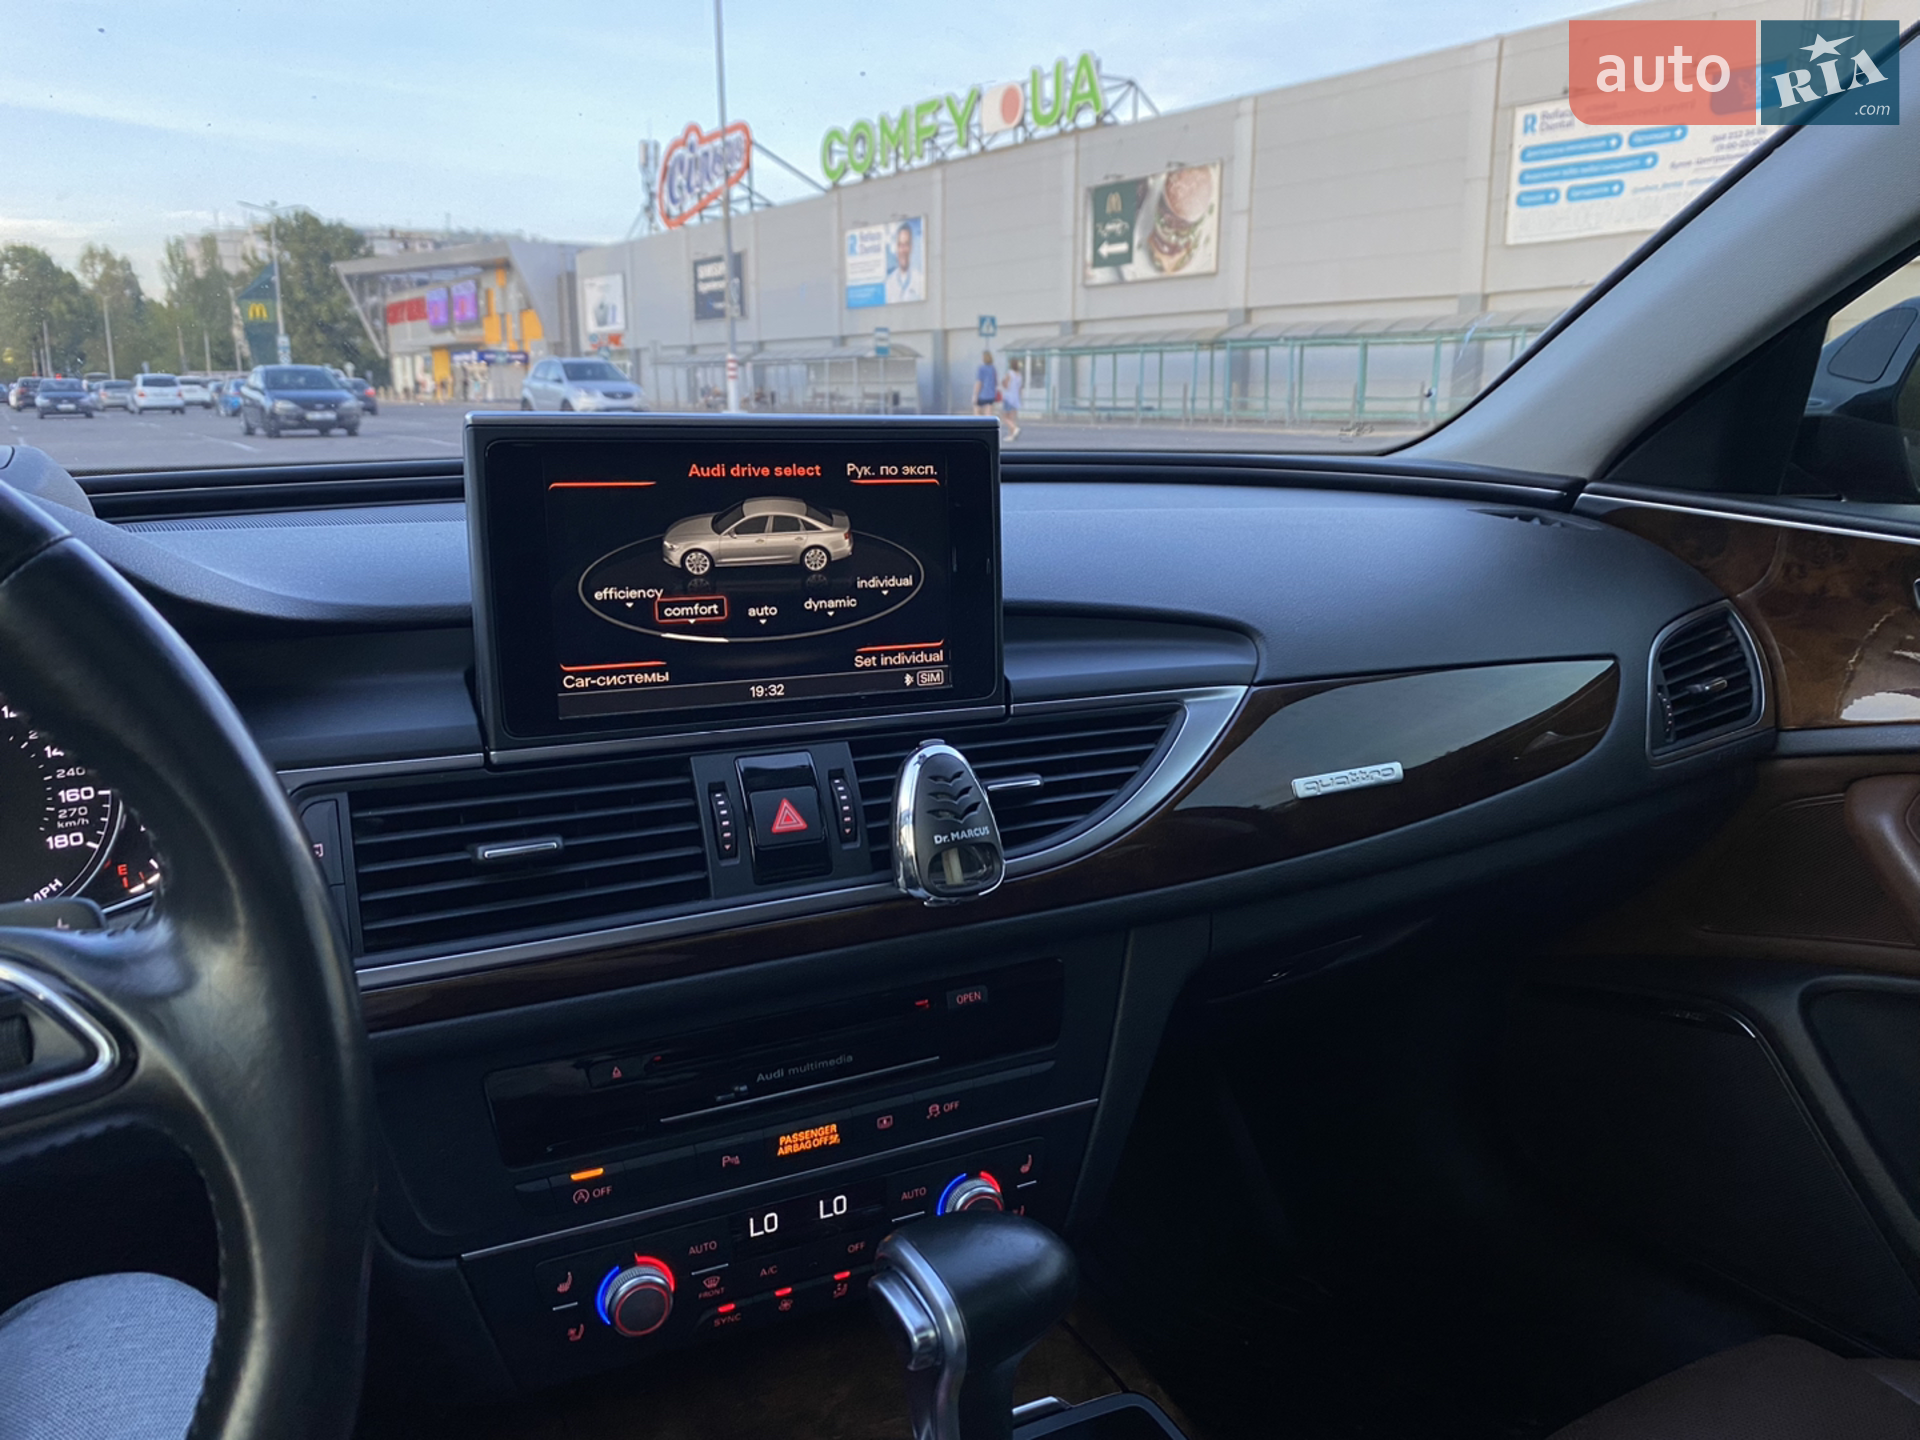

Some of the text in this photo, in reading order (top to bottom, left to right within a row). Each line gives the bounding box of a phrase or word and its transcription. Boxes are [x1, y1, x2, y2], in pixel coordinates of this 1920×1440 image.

[821, 53, 1103, 183] COMFY UA
[688, 463, 822, 477] Audi drive select
[847, 463, 938, 479] Рук. по эксп.
[856, 575, 913, 589] individual
[594, 587, 664, 601] efficiency
[663, 603, 719, 617] comfort
[747, 605, 778, 617] auto
[803, 596, 857, 612] dynamic
[854, 650, 944, 668] Set individual
[562, 671, 670, 689] Car-системы
[920, 672, 941, 684] SIM
[749, 684, 785, 698] 19:32
[56, 766, 86, 779] 240
[1303, 767, 1395, 796] quattro
[58, 786, 95, 803] 160
[58, 806, 88, 819] 270
[56, 818, 90, 829] km/h
[45, 832, 85, 850] 180
[933, 826, 990, 846] Dr. MARCUS
[955, 991, 982, 1005] OPEN
[756, 1053, 854, 1083] Audi multimedia
[943, 1101, 960, 1113] OFF
[779, 1123, 838, 1146] PASSENGER
[776, 1135, 829, 1157] AIRBAG OFF
[592, 1185, 613, 1199] OFF
[901, 1186, 927, 1200] AUTO
[819, 1195, 848, 1219] LO
[749, 1212, 779, 1238] LO
[688, 1240, 718, 1255] AUTO
[847, 1241, 866, 1253] OFF
[759, 1265, 778, 1277] A/C
[698, 1287, 725, 1300] FRONT
[713, 1312, 742, 1327] SYNC
